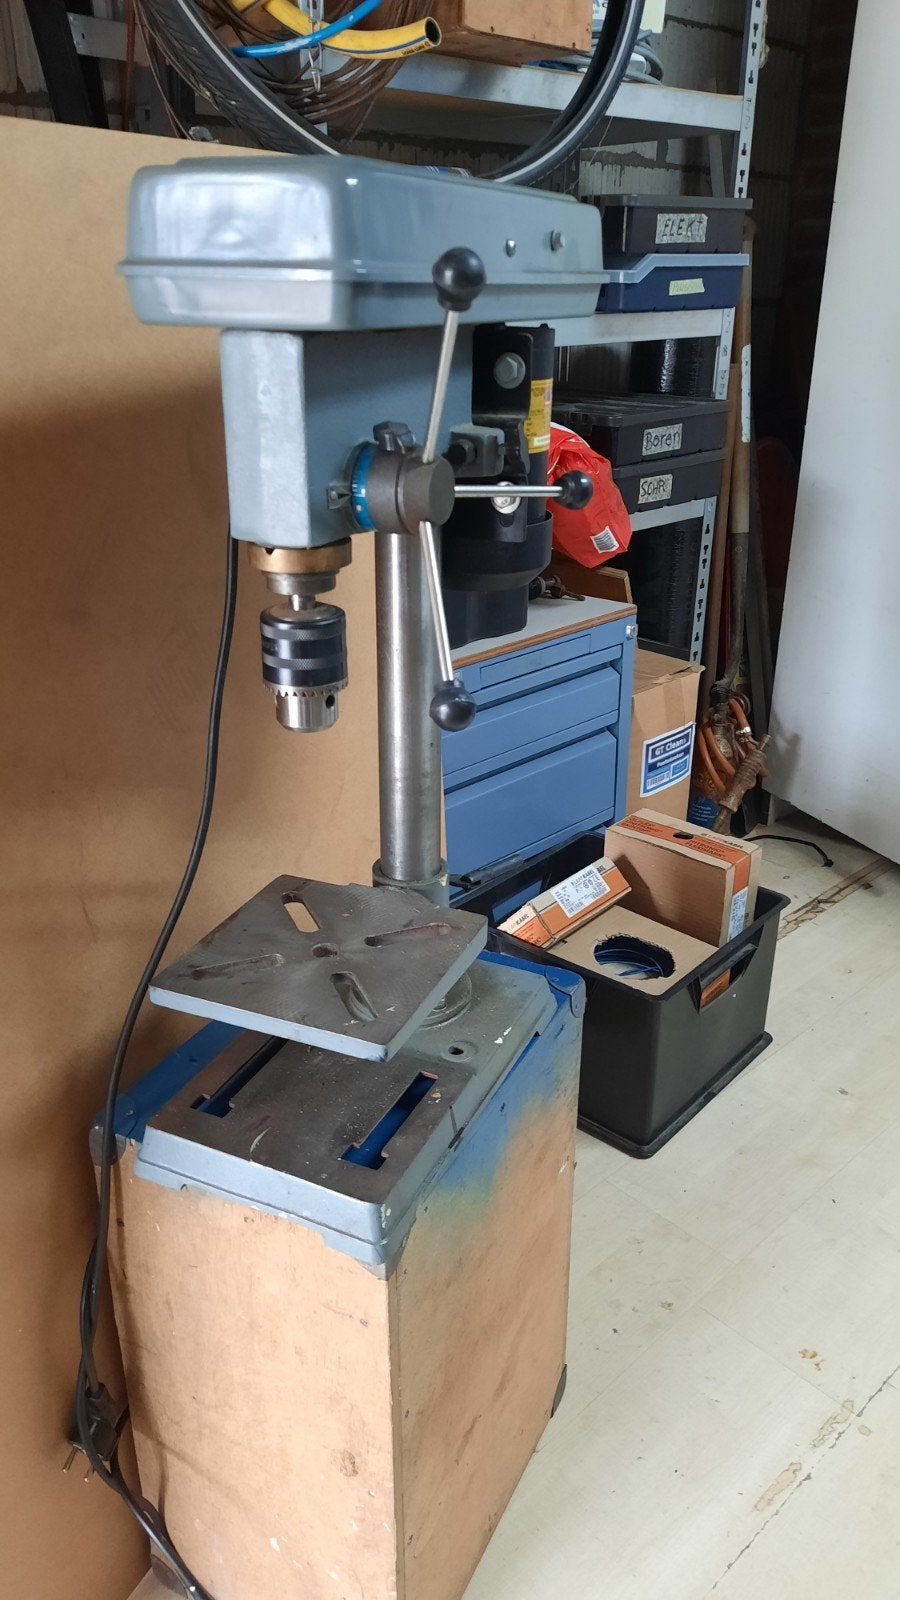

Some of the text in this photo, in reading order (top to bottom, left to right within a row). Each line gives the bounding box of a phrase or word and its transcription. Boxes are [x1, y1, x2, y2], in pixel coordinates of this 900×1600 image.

[644, 431, 680, 451] Boren
[641, 479, 666, 497] SCHR
[655, 746, 664, 756] GT
